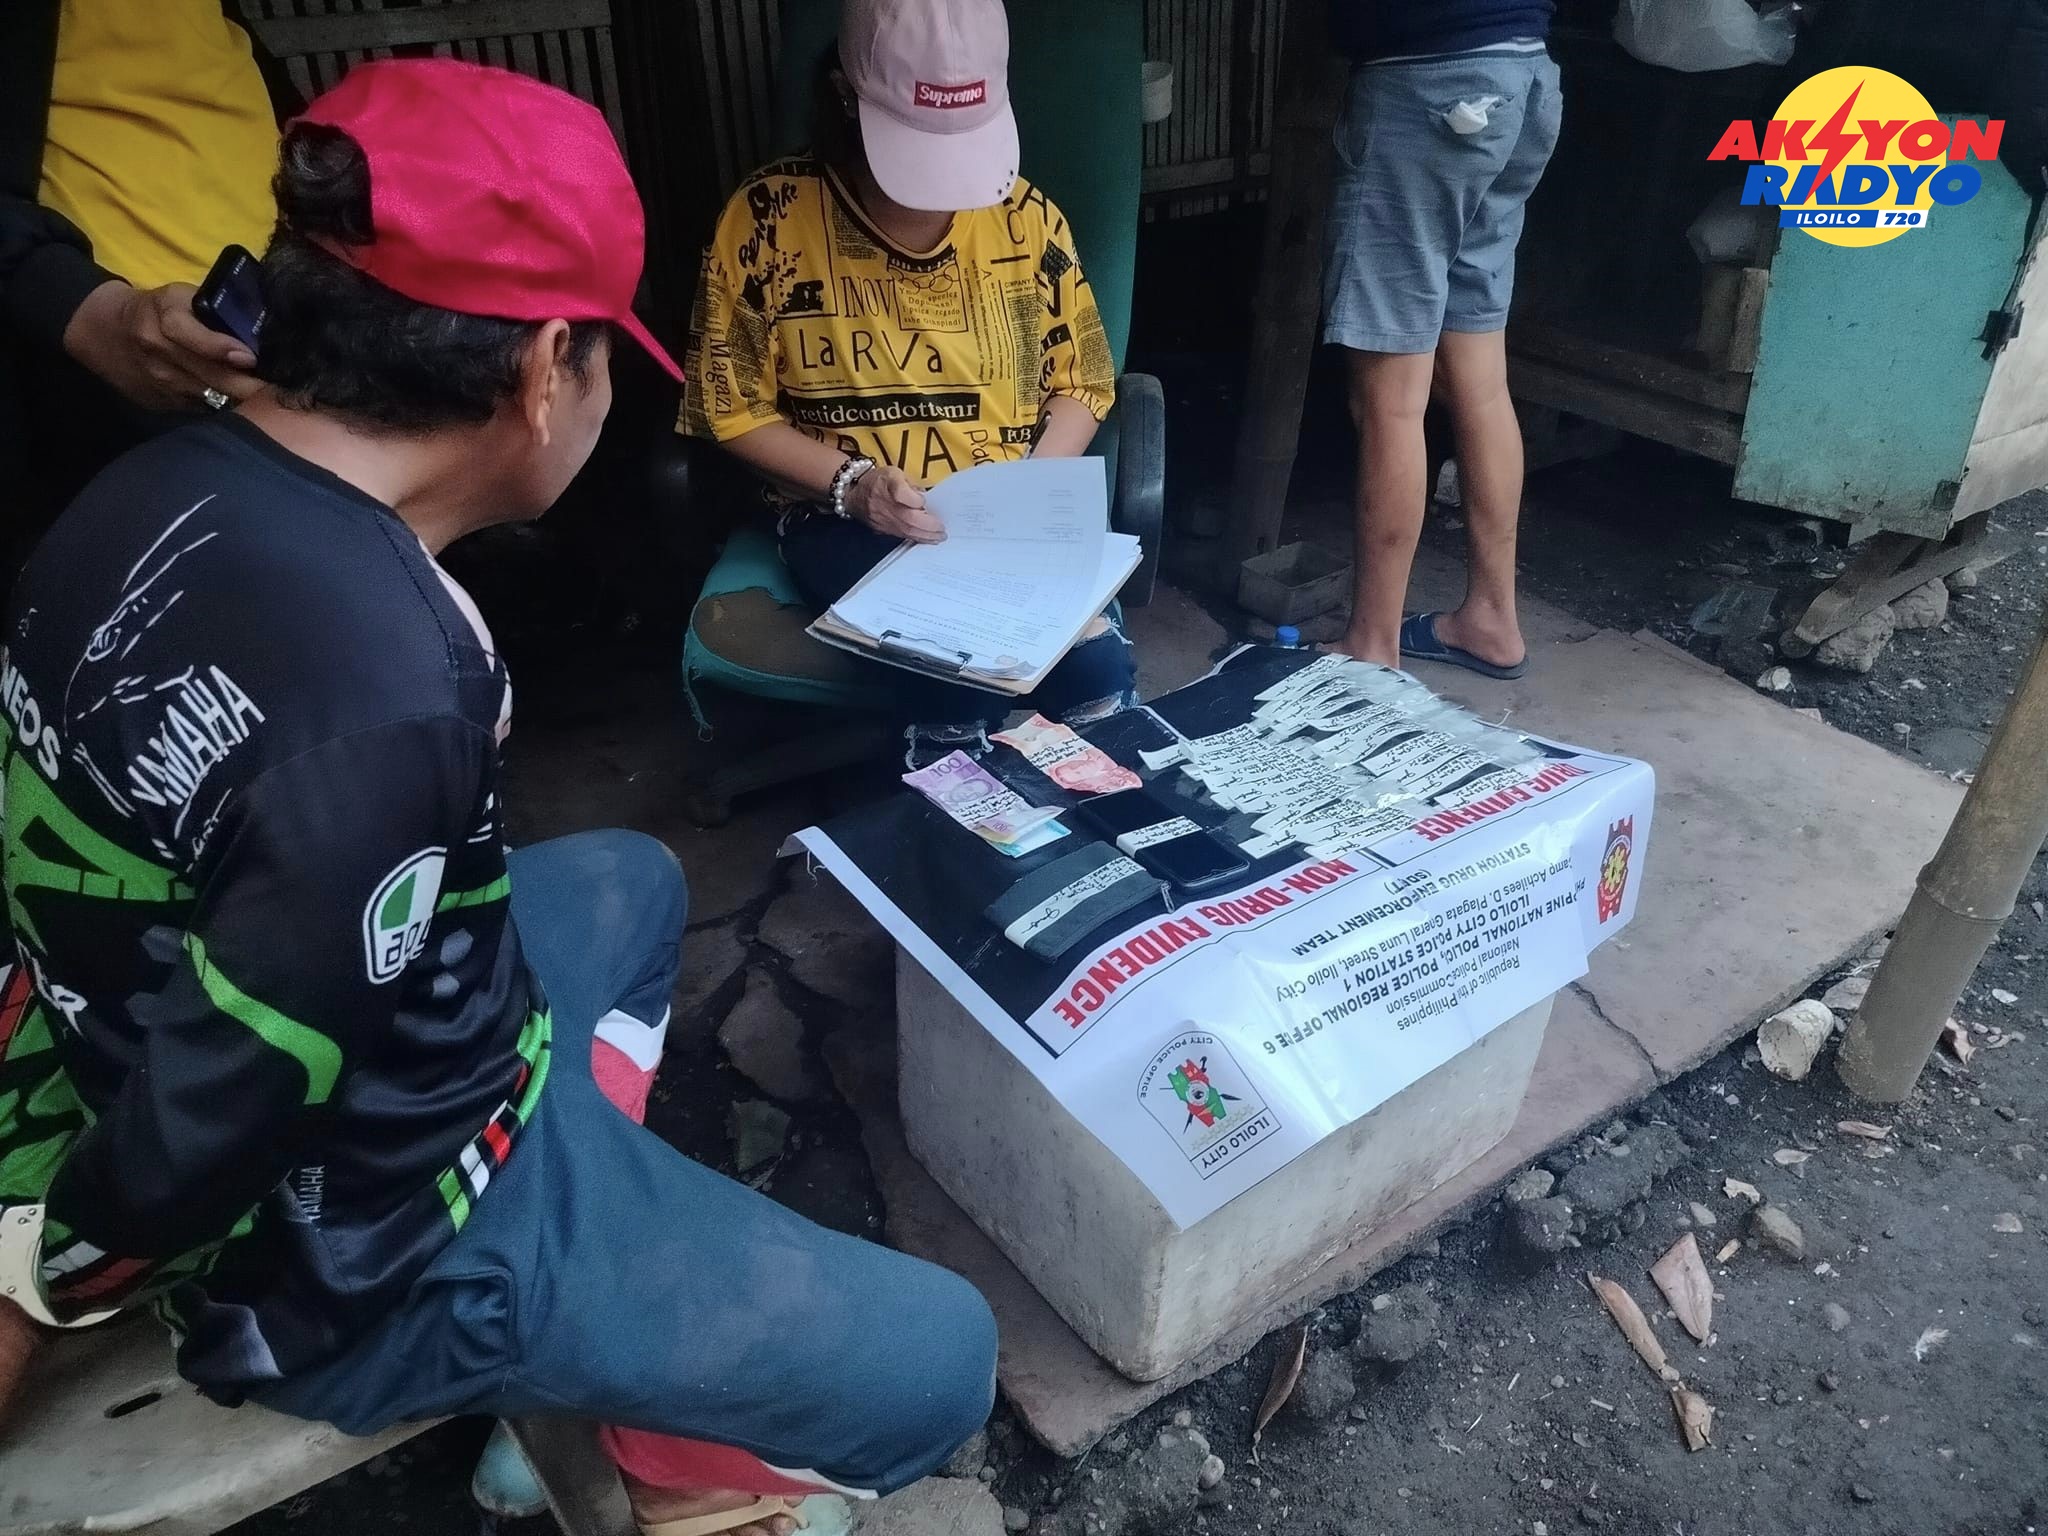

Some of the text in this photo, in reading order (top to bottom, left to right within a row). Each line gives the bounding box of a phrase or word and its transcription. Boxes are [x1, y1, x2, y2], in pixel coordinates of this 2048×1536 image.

[127, 665, 266, 806] YAMAHA
[1411, 786, 1534, 842] EVIDENCE
[1197, 859, 1359, 926] NON-DRUG
[1489, 889, 1502, 902] D.
[1503, 869, 1547, 896] Achilees
[1291, 843, 1532, 956] STATION DRUG ENFORCEMENT TEAM
[1446, 898, 1488, 921] Plagata
[1490, 893, 1529, 922] ILOILO
[1456, 914, 1486, 937] CITY
[1482, 905, 1543, 941] NATIONAL
[1380, 932, 1411, 953] Luna
[1440, 935, 1480, 965] POLIC,
[1480, 937, 1520, 964] National
[1053, 916, 1212, 1029] EVIDENCE
[1339, 947, 1380, 972] Street,
[1355, 949, 1414, 988] STATION
[1480, 955, 1520, 984] Republic
[1307, 965, 1339, 988] Iloilo
[1343, 979, 1352, 993] 1
[1392, 959, 1439, 992] POLICE
[1467, 978, 1478, 993] of
[1276, 980, 1307, 1002] City
[1322, 982, 1389, 1024] REGIONAL
[1397, 996, 1458, 1031] Philippines
[1156, 1039, 1187, 1063] POLICE
[1262, 1041, 1276, 1055] 6
[1140, 1065, 1158, 1098] OFFICE
[1202, 1117, 1270, 1169] ILOILO CITY
